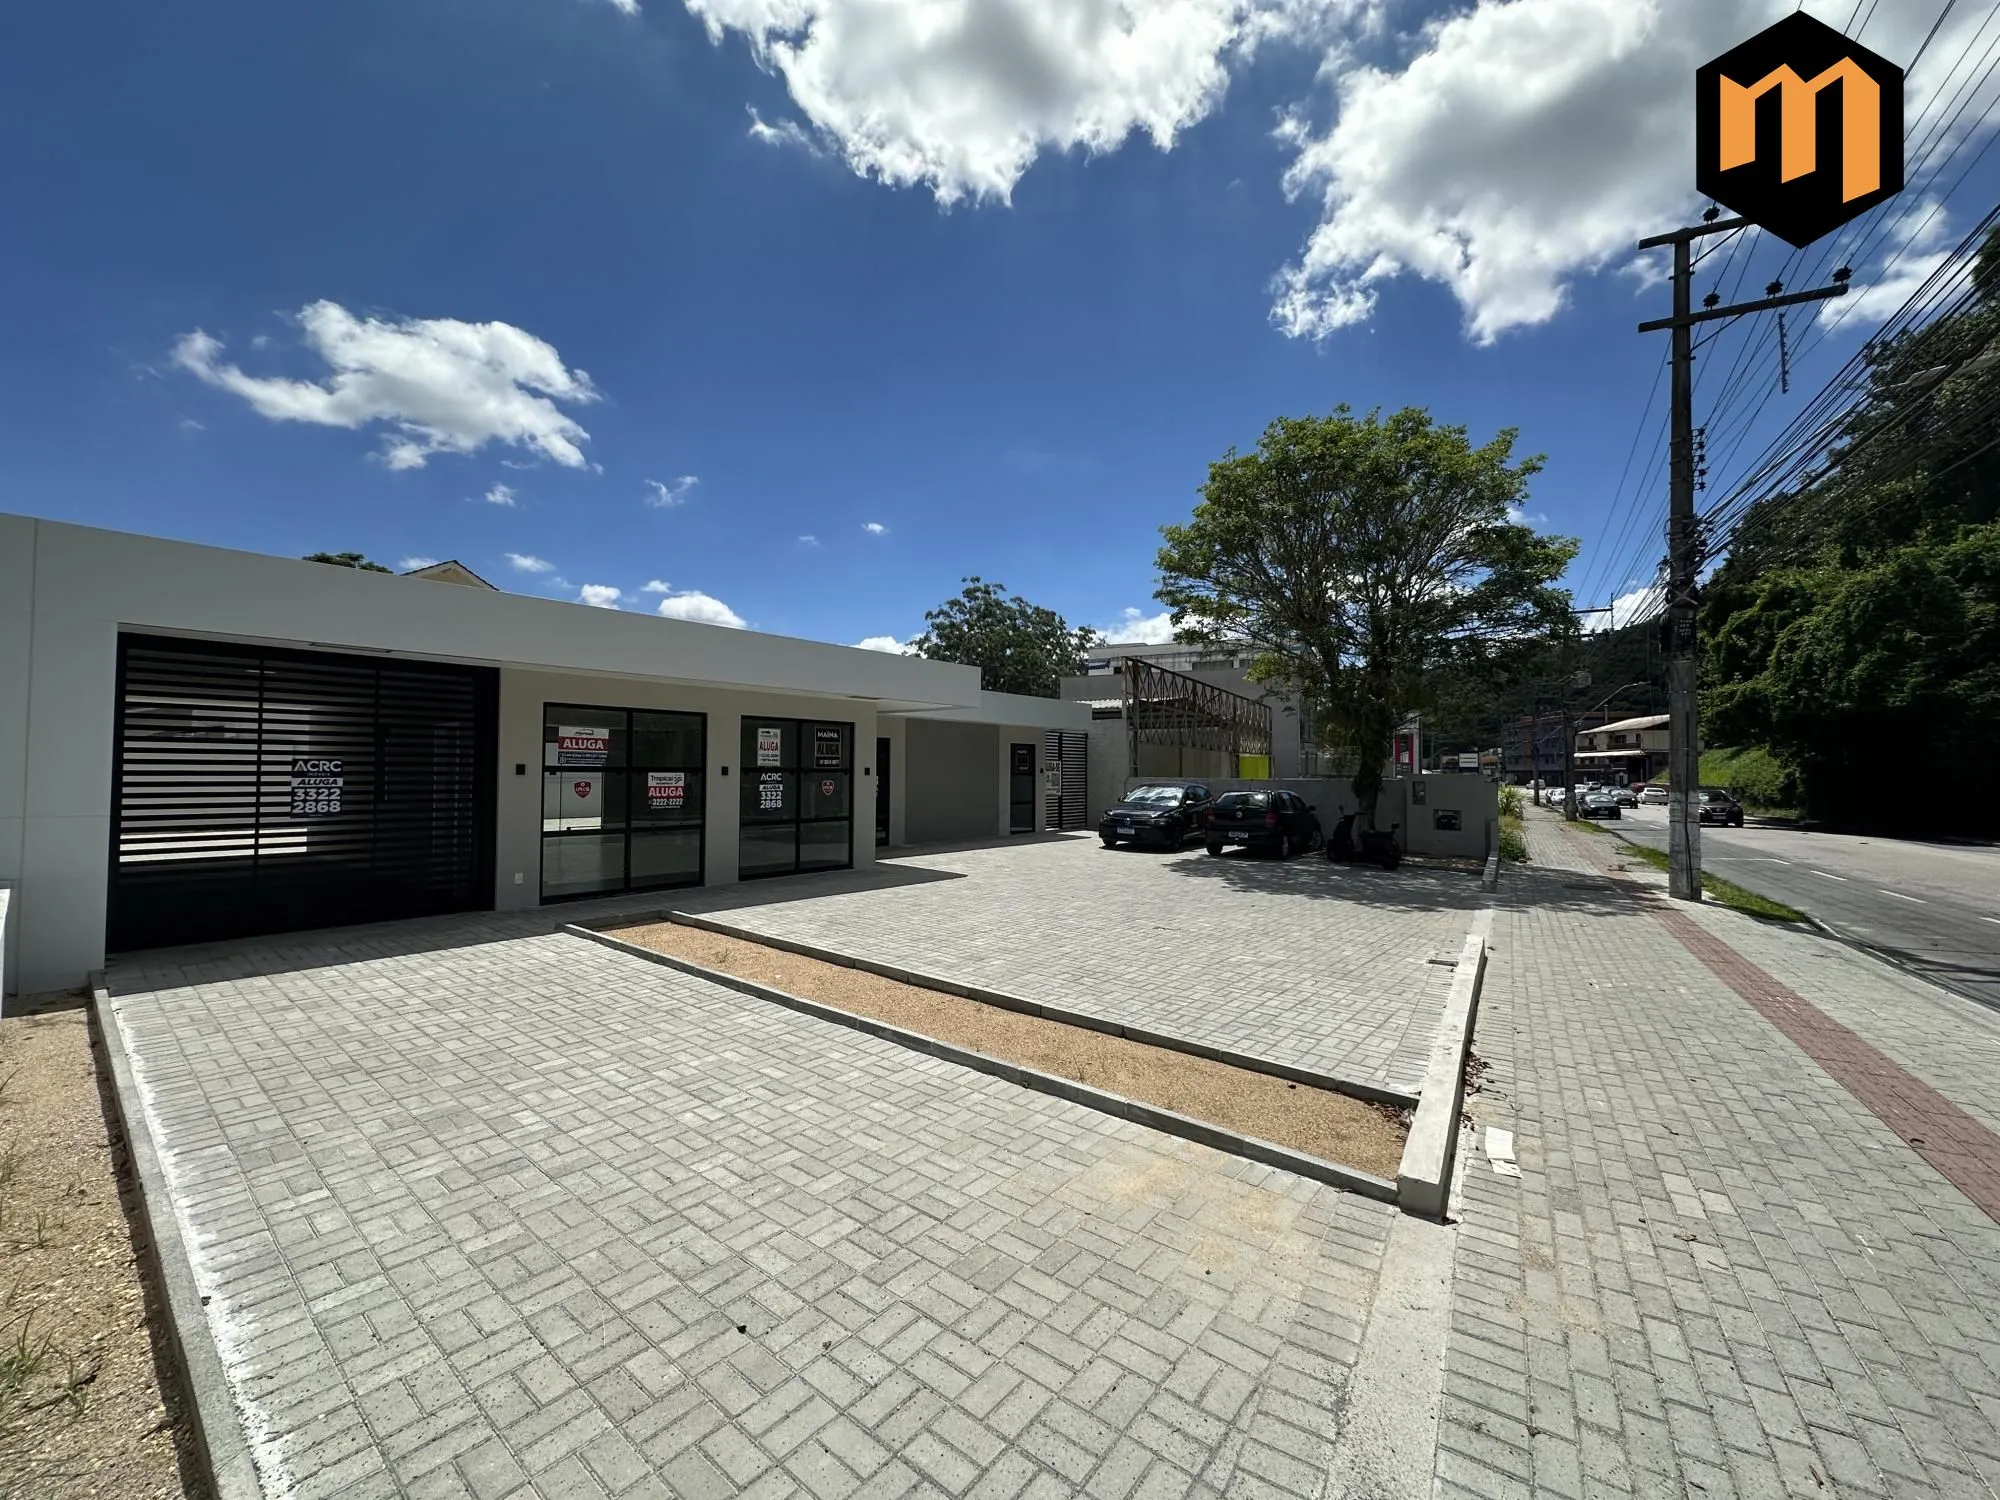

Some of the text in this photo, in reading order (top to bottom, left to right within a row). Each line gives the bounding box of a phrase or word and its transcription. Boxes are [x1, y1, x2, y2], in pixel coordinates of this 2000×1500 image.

[563, 738, 604, 749] ALUGA
[760, 741, 779, 751] ALUGA
[817, 743, 840, 755] ALUGA
[294, 760, 342, 771] ACRC
[760, 772, 782, 781] ACRC
[293, 788, 341, 800] 3322
[649, 787, 683, 797] ALUGA
[760, 791, 782, 800] 3322
[292, 801, 341, 813] 2868
[760, 800, 782, 808] 2868
